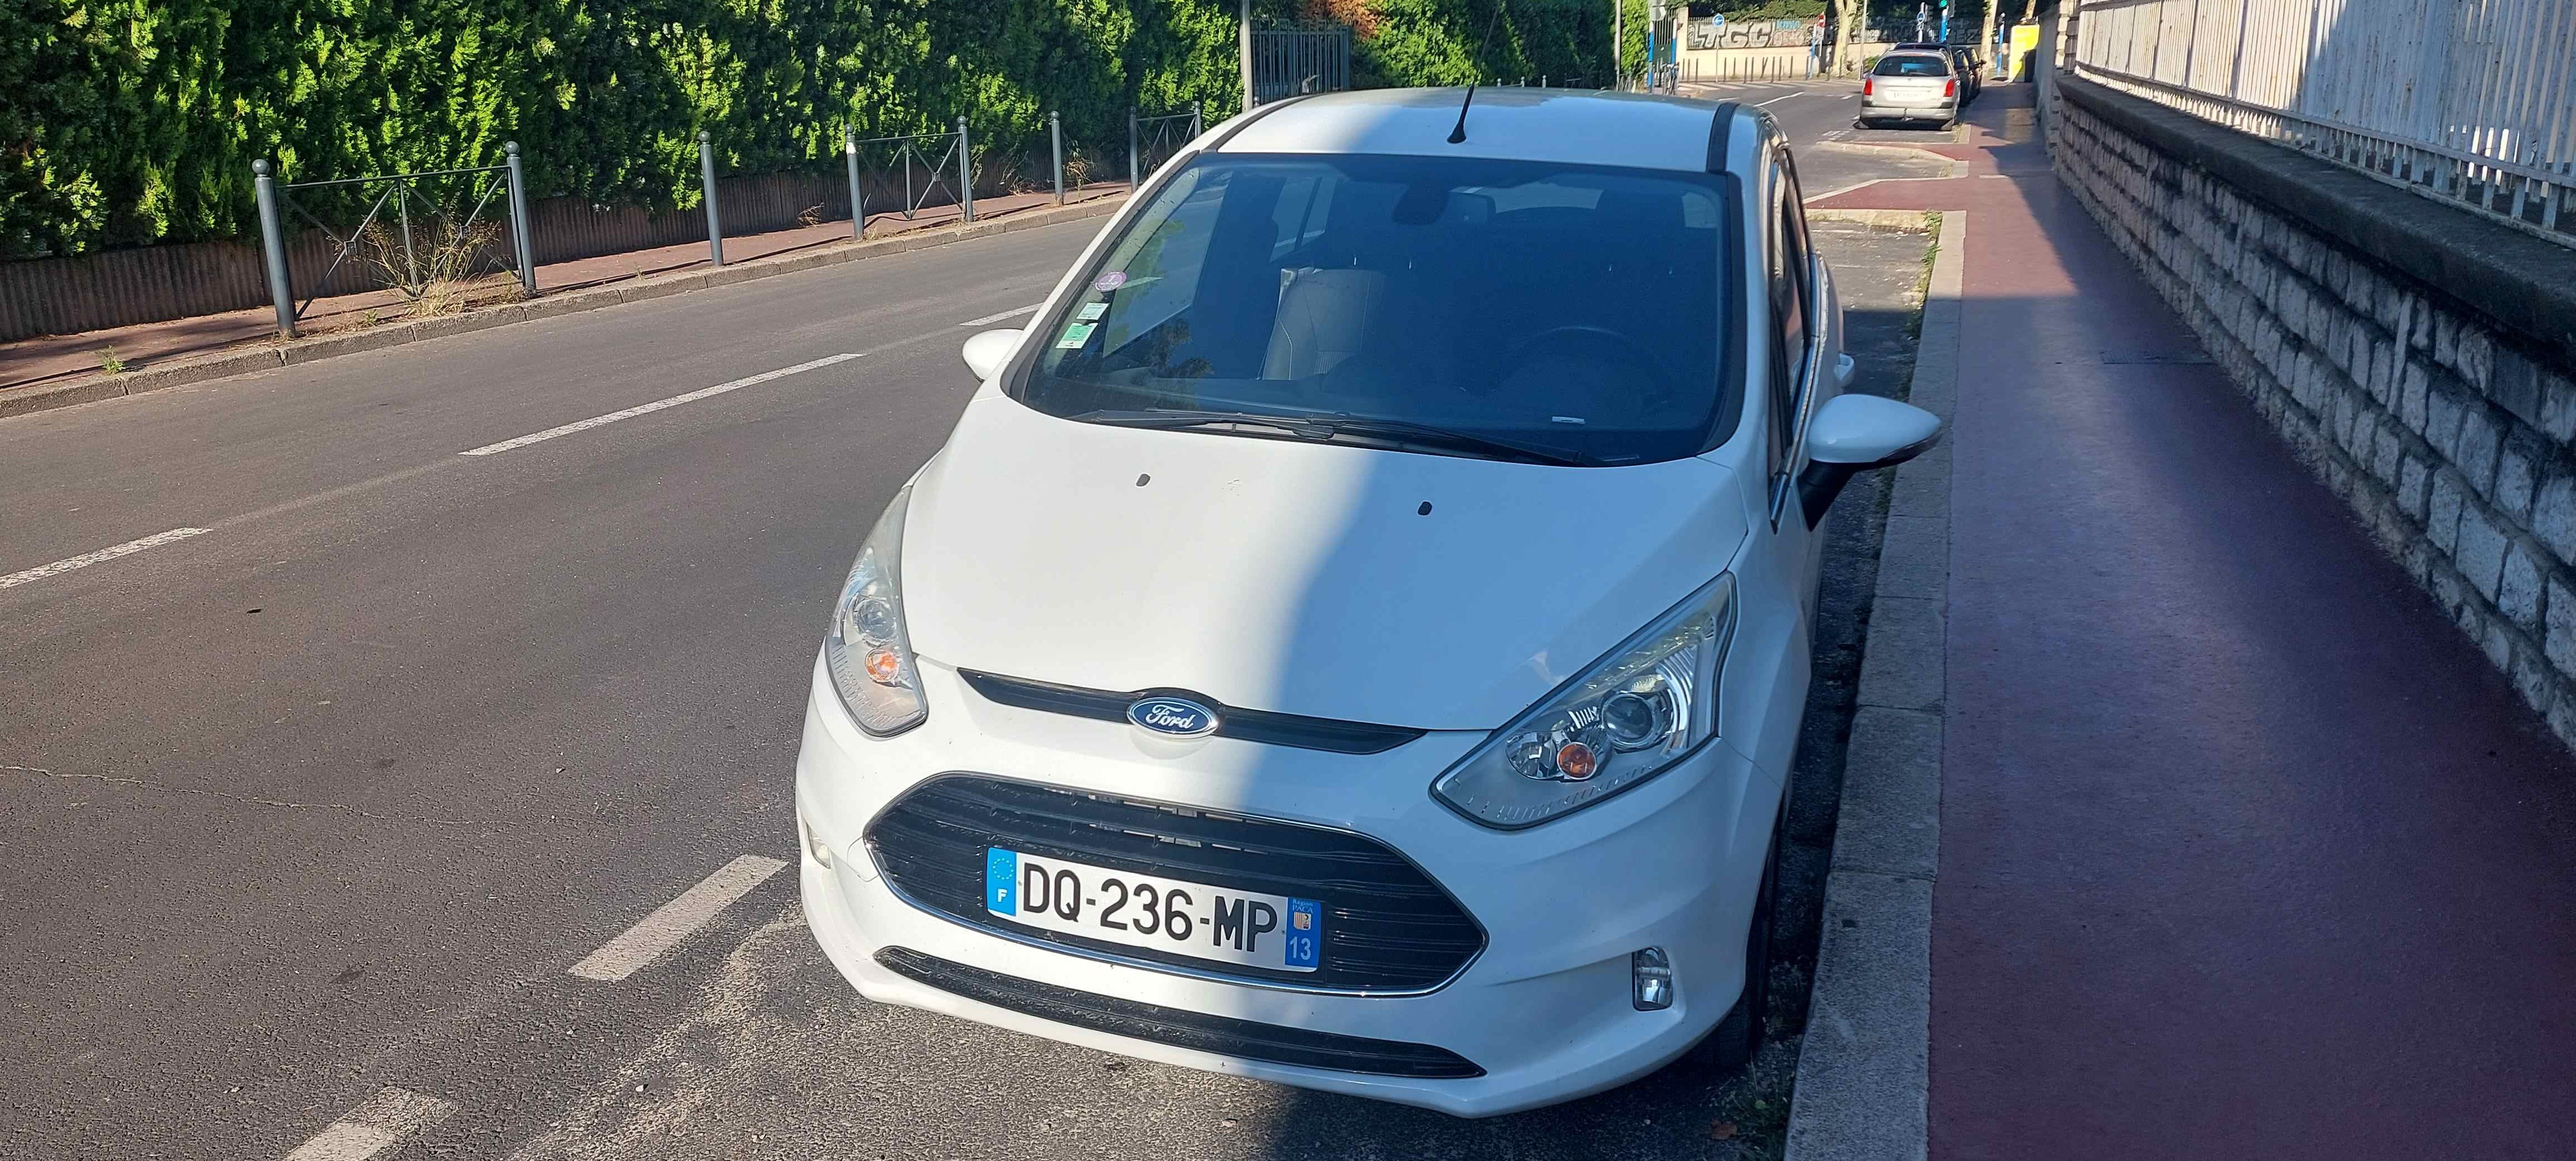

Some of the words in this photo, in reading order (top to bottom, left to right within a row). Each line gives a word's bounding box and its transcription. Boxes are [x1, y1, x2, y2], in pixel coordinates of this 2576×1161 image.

[1145, 704, 1196, 729] Ford
[997, 889, 1008, 903] F
[1292, 899, 1314, 907] Région
[1023, 862, 1277, 953] DQ-236-MP
[1292, 905, 1314, 914] PACA
[1290, 936, 1311, 960] 13
